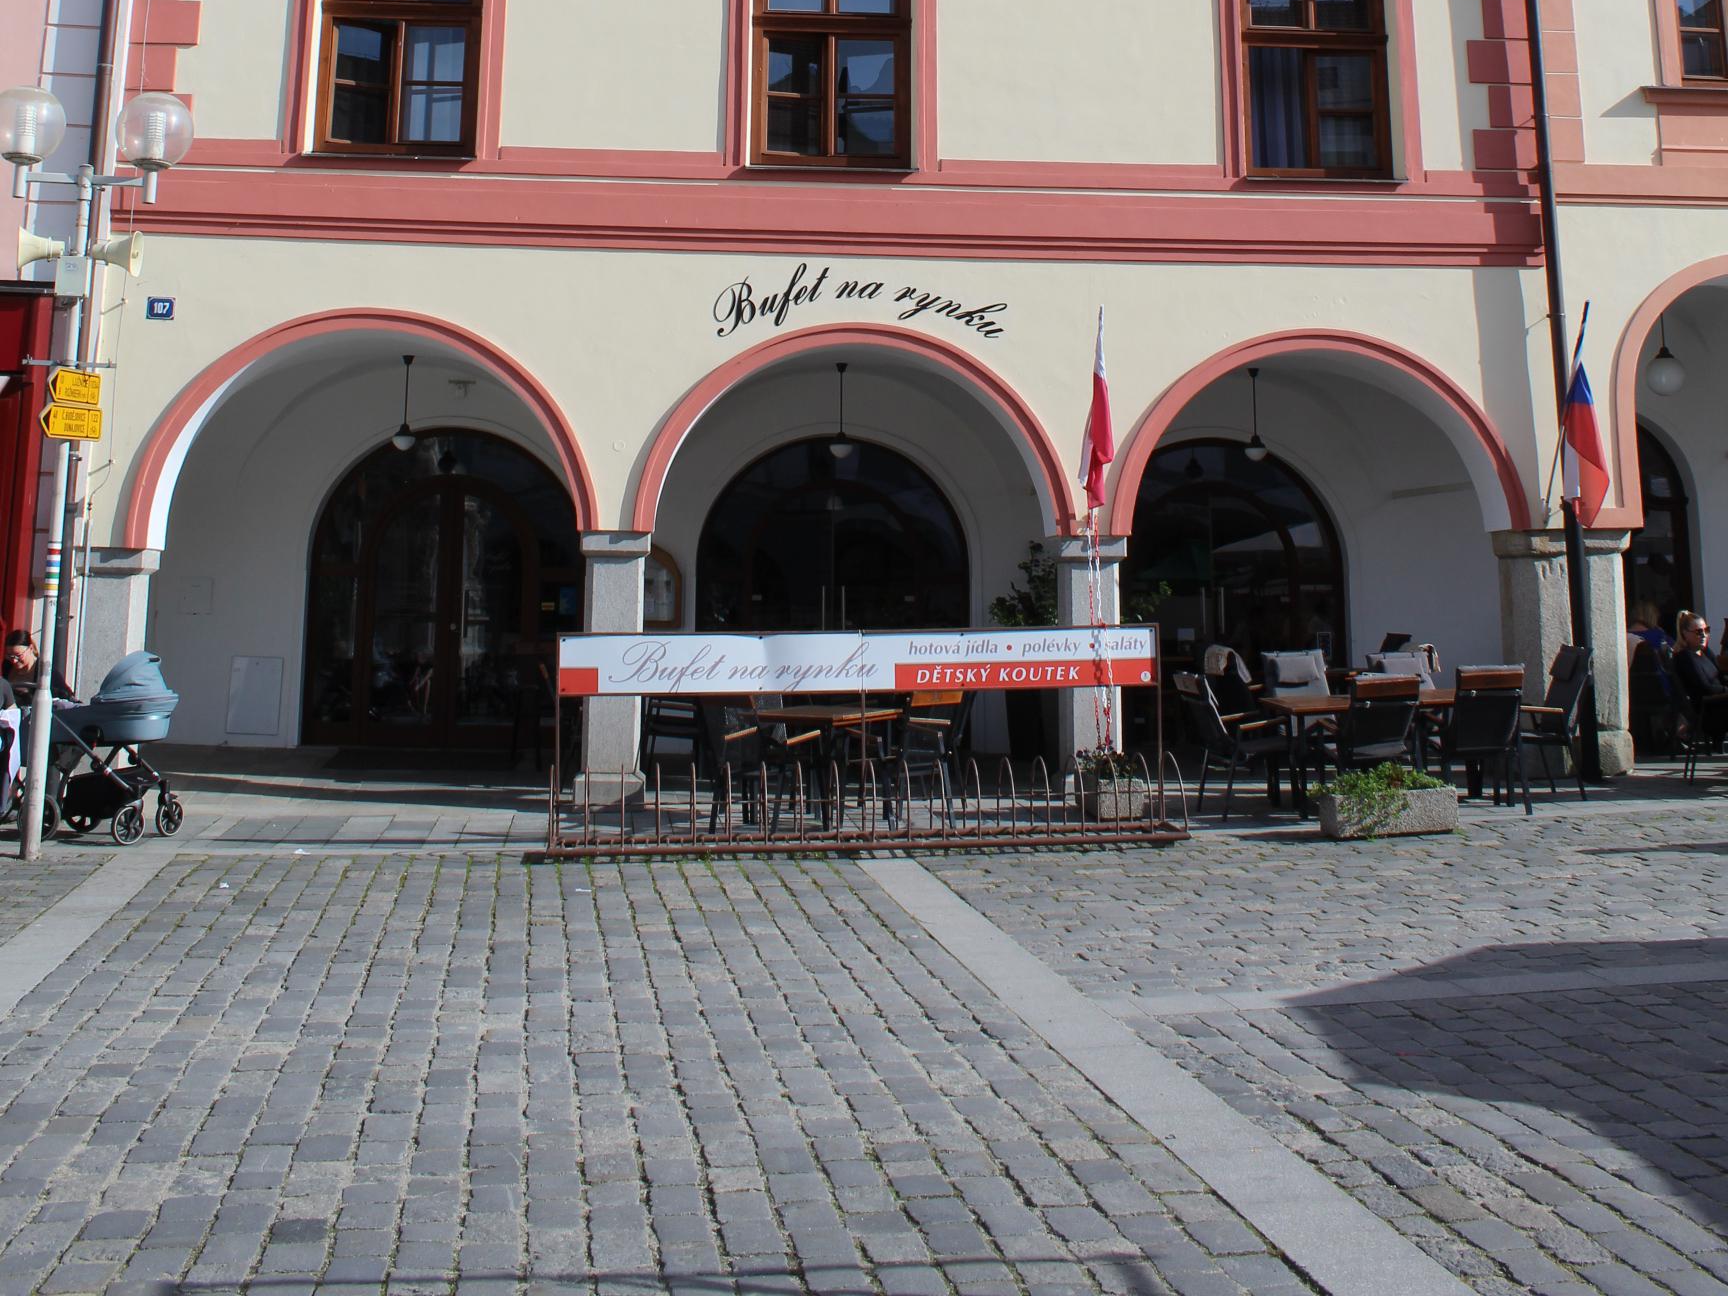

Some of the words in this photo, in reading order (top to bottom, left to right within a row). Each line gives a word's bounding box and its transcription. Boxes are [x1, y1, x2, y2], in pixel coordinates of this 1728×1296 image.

[153, 302, 170, 314] 107
[713, 263, 830, 338] Bufet
[835, 279, 885, 300] na
[893, 285, 1008, 339] rynku
[908, 641, 961, 656] hotová
[964, 639, 999, 657] jídla
[1022, 637, 1081, 657] polévky
[608, 640, 726, 693] Bufet
[728, 662, 771, 680] na
[774, 641, 880, 692] rynku
[916, 663, 991, 684] DĚTSKÝ
[999, 665, 1081, 683] KOUTEK
